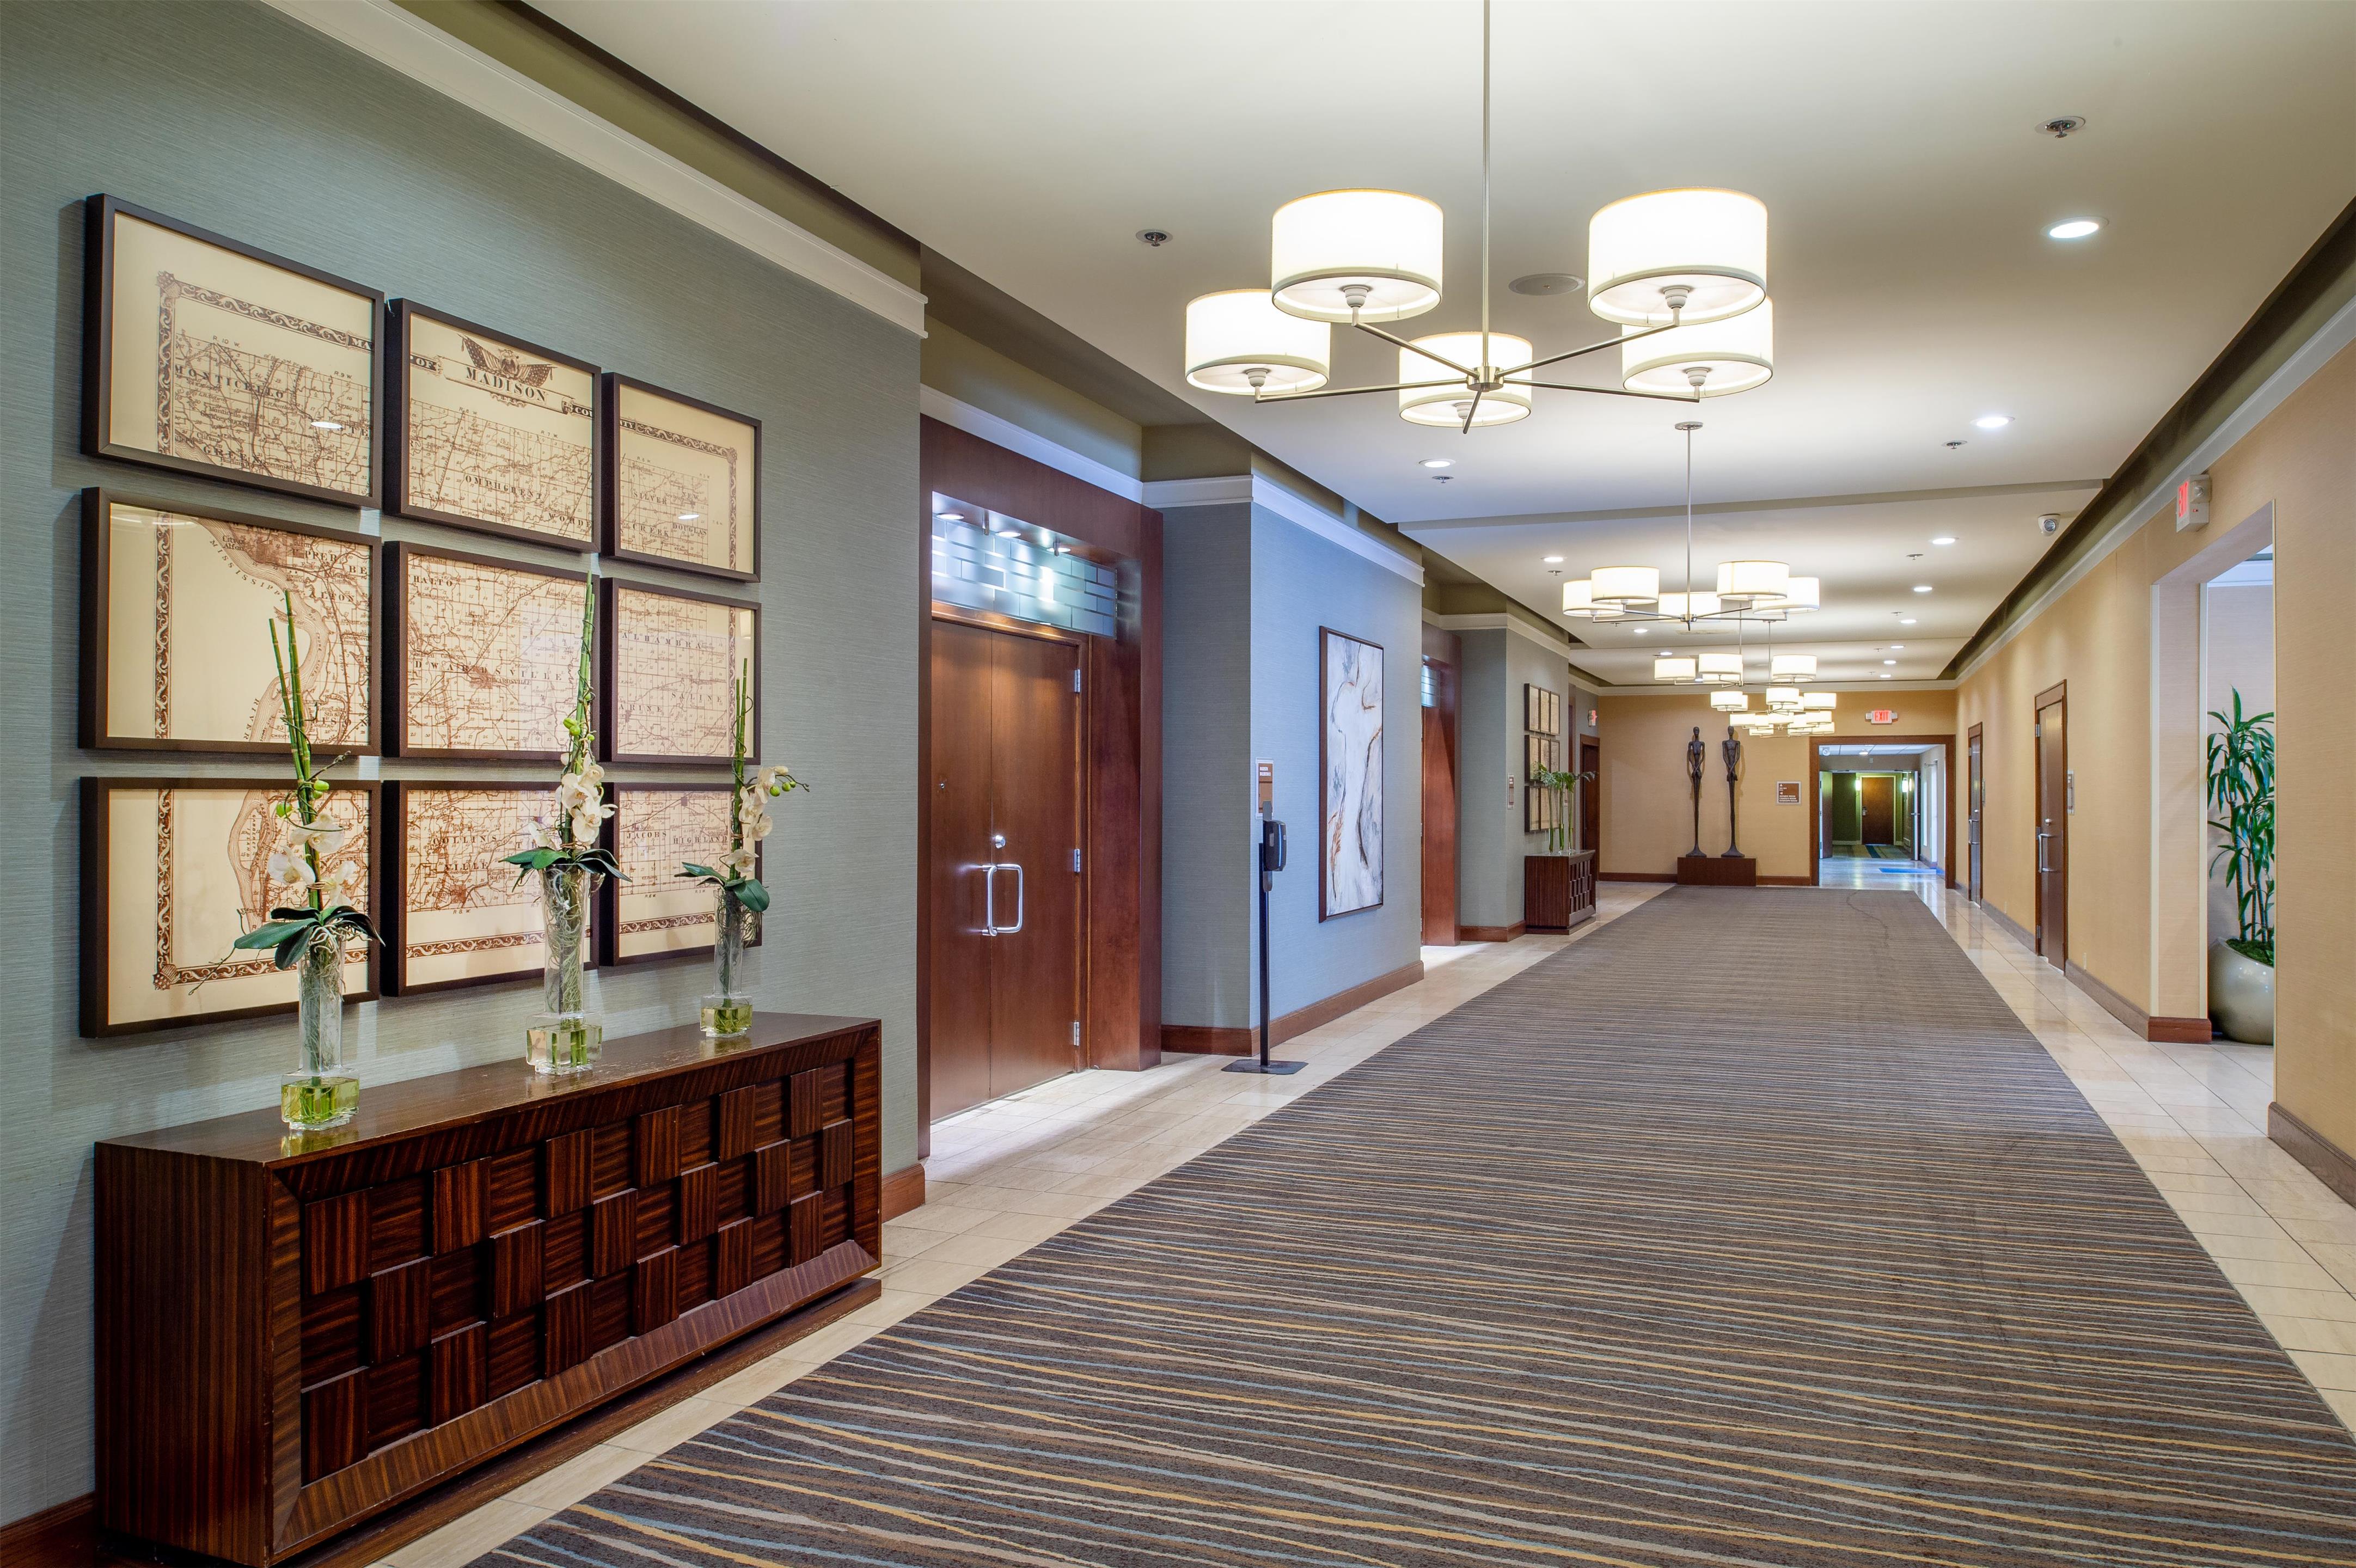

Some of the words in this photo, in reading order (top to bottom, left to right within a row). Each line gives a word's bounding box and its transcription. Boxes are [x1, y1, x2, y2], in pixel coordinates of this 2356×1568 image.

[416, 358, 433, 369] OF
[175, 365, 283, 399] MONTICELLO
[466, 366, 547, 403] MADISON
[633, 492, 668, 505] SILVER
[682, 491, 699, 500] NEW
[632, 524, 669, 537] CREEK
[673, 522, 707, 535] DOUGLAS
[210, 539, 285, 602] MISSISSIPPI
[413, 575, 453, 587] HALTO
[309, 591, 354, 602] ALTON
[622, 632, 701, 649] ALHAMBRA
[671, 692, 722, 703] SALINE
[243, 698, 260, 740] RIVER
[1875, 710, 1889, 722] EXIT
[433, 835, 497, 844] COLLINS
[674, 836, 727, 844] HIGHLAND
